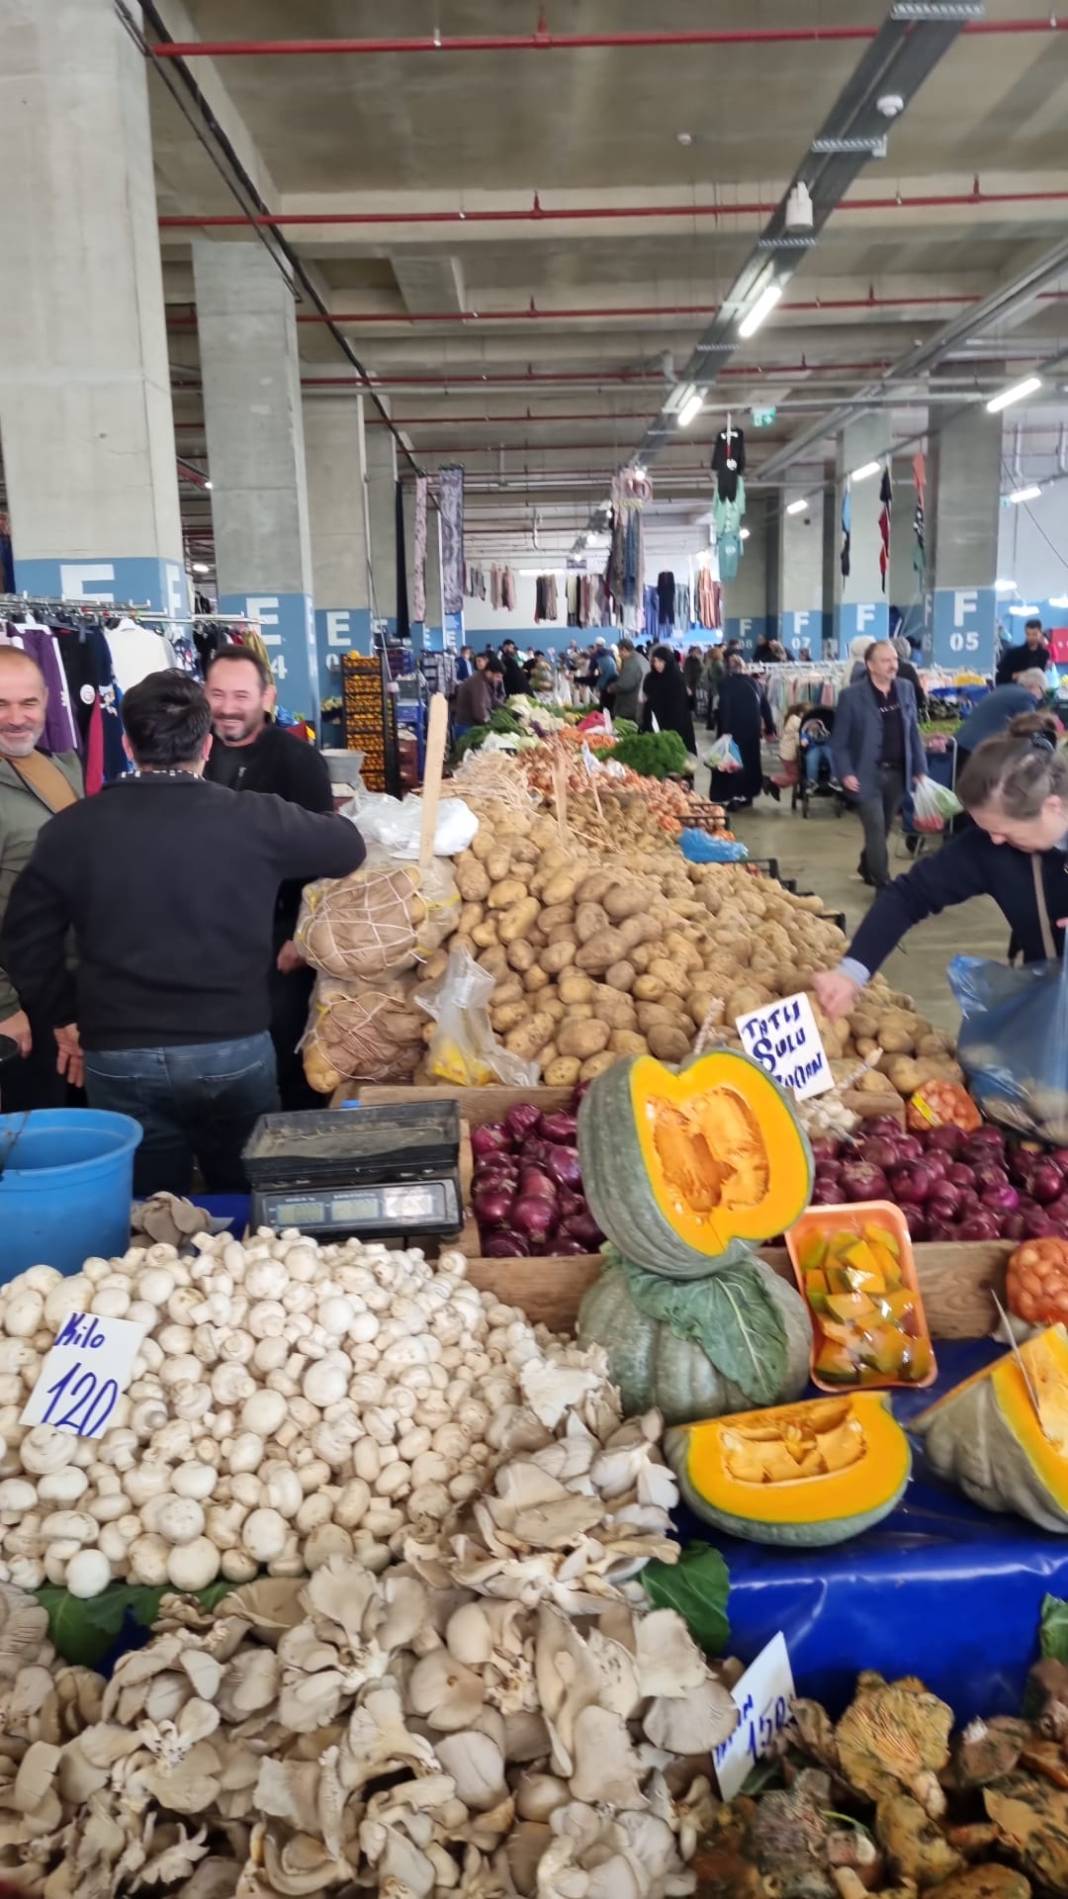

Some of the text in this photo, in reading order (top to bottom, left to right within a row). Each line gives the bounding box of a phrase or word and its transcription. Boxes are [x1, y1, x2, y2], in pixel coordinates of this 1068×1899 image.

[246, 597, 282, 645] E
[793, 611, 810, 635] F
[857, 604, 875, 632] F
[954, 592, 978, 627] F
[326, 611, 352, 646] E
[739, 618, 752, 638] F
[791, 636, 811, 650] 07
[950, 632, 979, 652] 05
[53, 1312, 105, 1349] Kilo
[40, 1362, 118, 1438] 120
